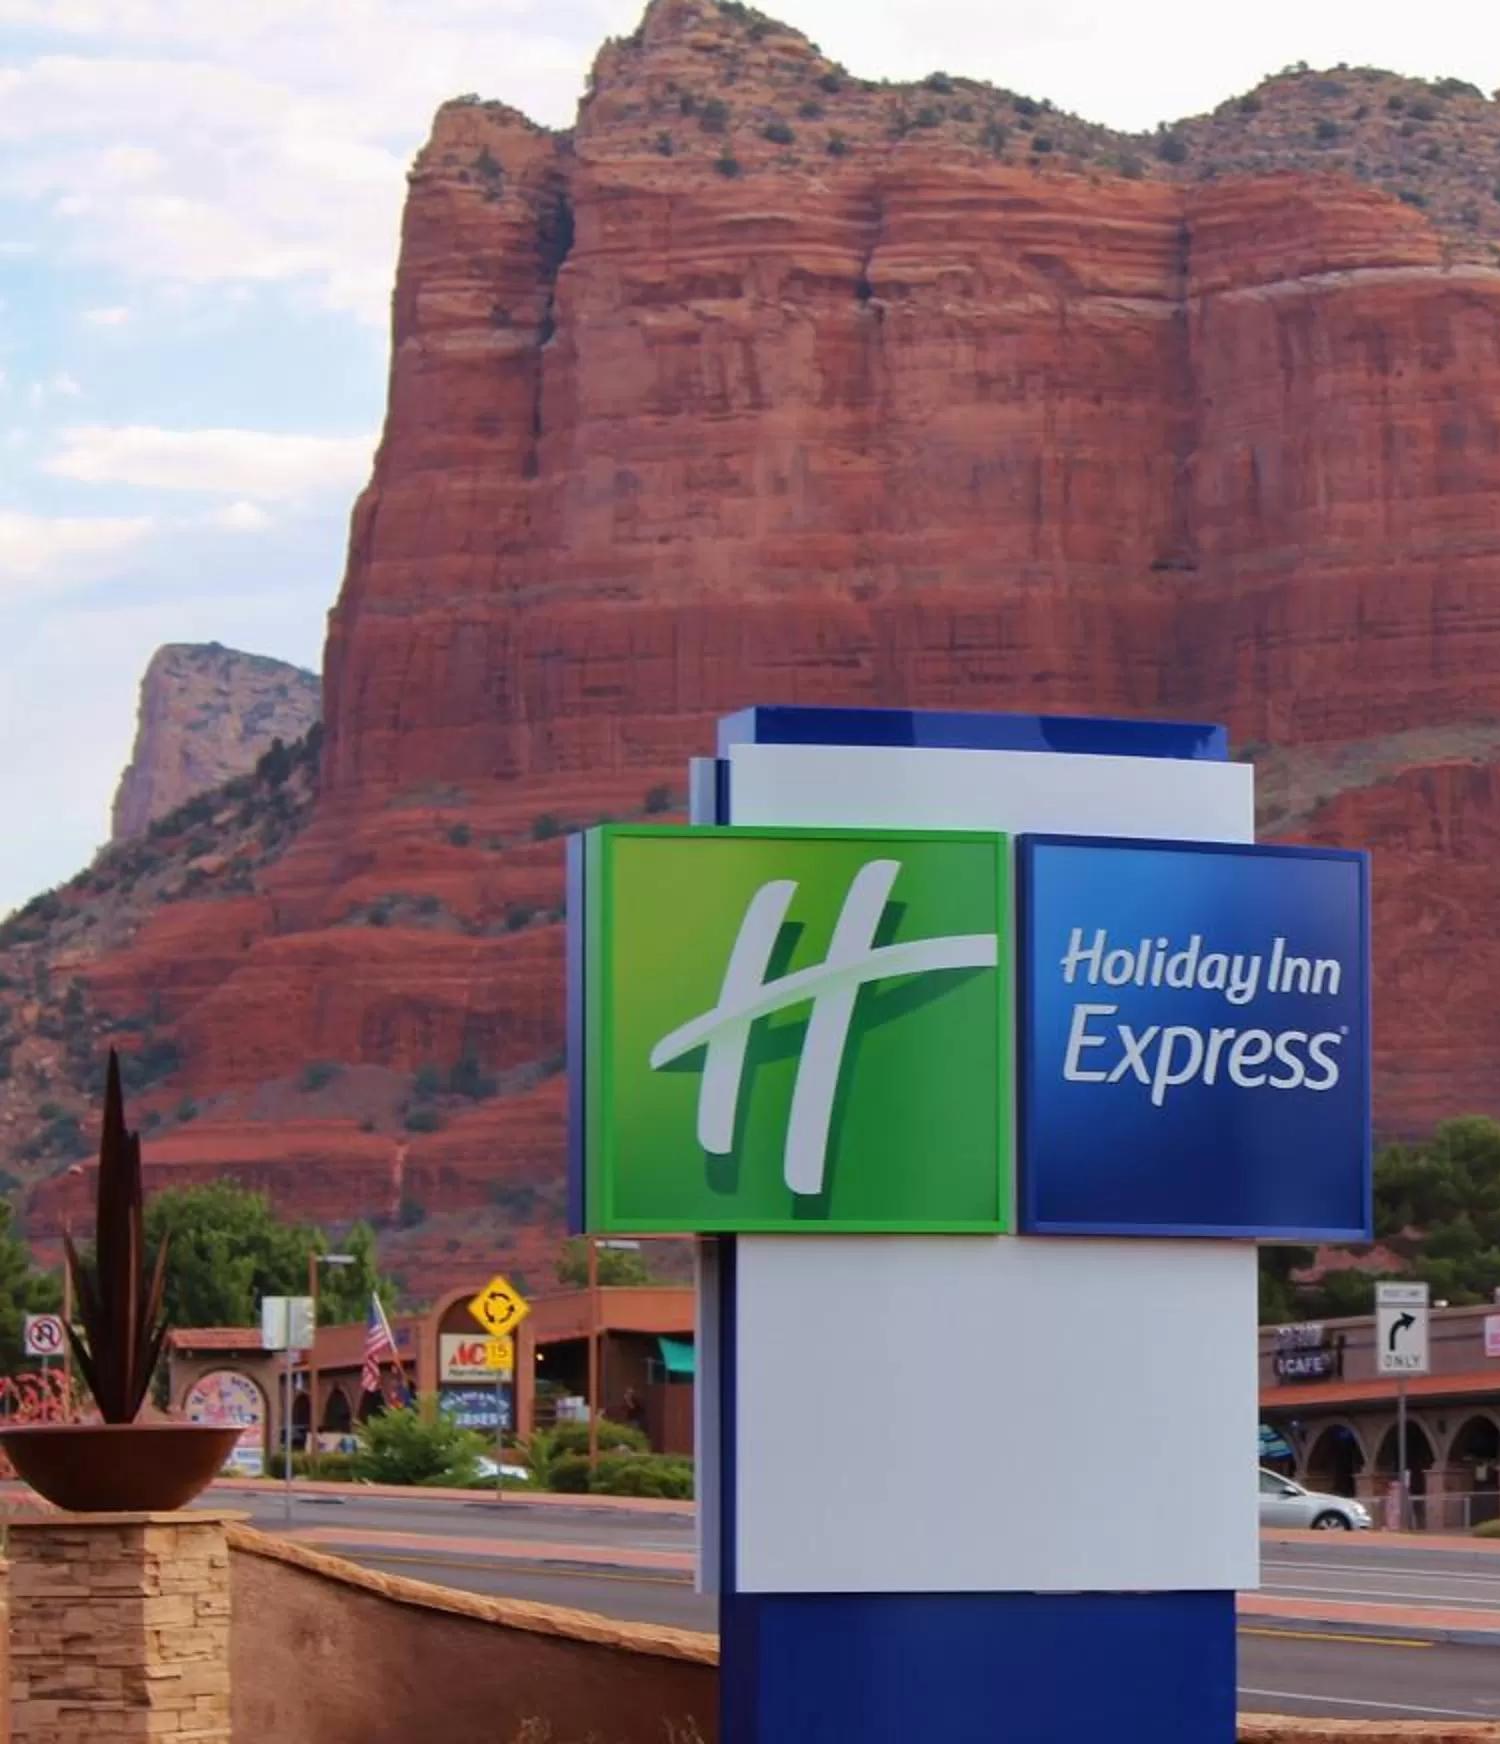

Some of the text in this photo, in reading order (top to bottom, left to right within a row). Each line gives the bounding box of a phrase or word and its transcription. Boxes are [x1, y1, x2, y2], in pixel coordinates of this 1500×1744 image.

[1060, 927, 1342, 1005] Holiday Inn
[1062, 1002, 1343, 1107] Express
[1384, 1353, 1421, 1369] ONLY
